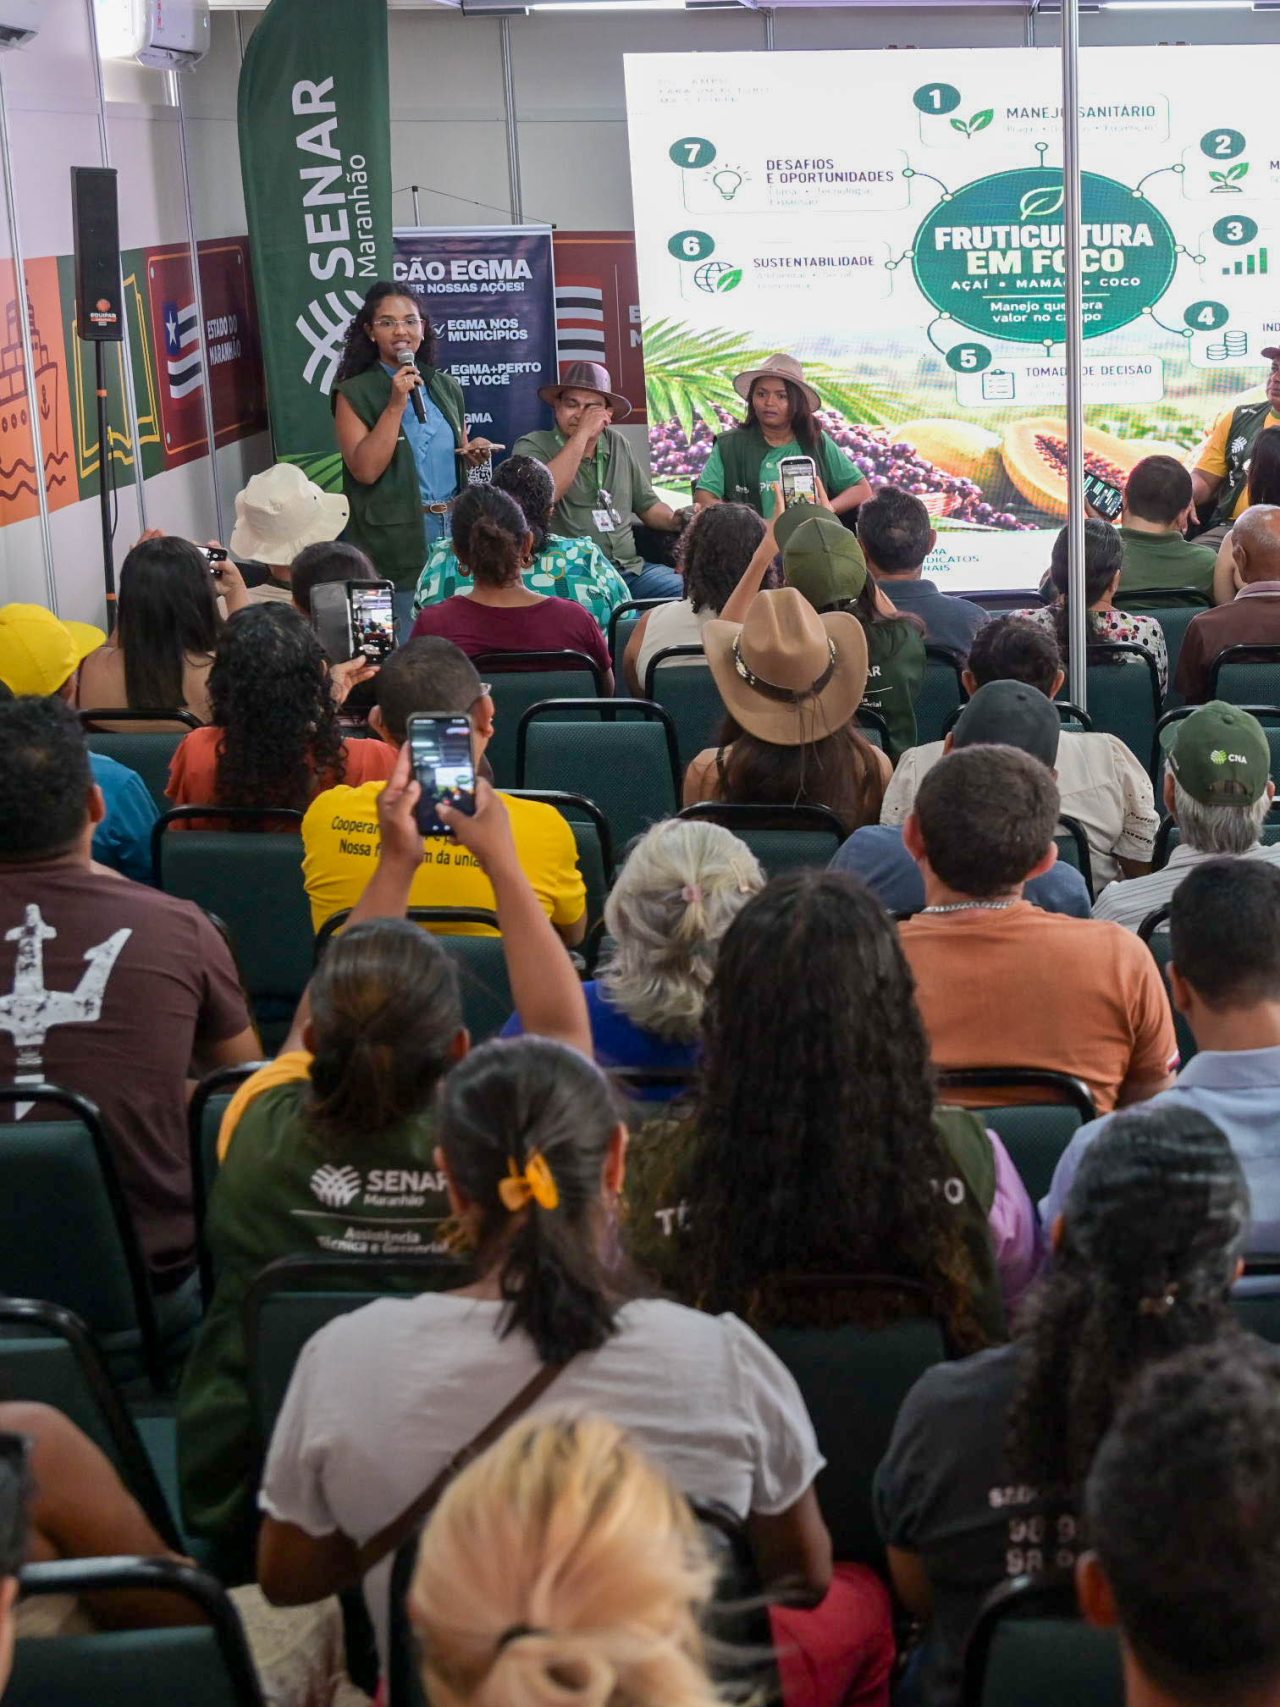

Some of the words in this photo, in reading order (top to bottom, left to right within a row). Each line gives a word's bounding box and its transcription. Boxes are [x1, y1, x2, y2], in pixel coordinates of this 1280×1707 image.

[930, 90, 940, 109] 1
[1006, 106, 1063, 118] MANEJ
[1215, 135, 1232, 154] 2
[683, 144, 701, 163] 7
[767, 159, 834, 171] DESAFIOS
[291, 76, 355, 281] SENAR
[767, 173, 774, 184] E
[780, 171, 894, 184] OPORTUNIDADES
[346, 154, 378, 277] Maranhão
[1227, 222, 1243, 241] 3
[682, 236, 701, 255] 6
[753, 255, 875, 268] SUSTENTABILIDADE
[966, 250, 1022, 275] EM
[450, 258, 533, 281] EGMA
[427, 282, 478, 294] NOSSAS
[480, 280, 525, 295] AÇÕES!
[951, 278, 988, 291] AÇAÍ
[1016, 276, 1065, 288] MAMÃ
[1100, 277, 1141, 287] COCO
[990, 301, 1039, 314] Manejo
[1081, 301, 1103, 311] era
[992, 312, 1027, 323] valor
[1033, 313, 1051, 323] no
[1197, 306, 1215, 325] 4
[447, 319, 485, 331] EGMA
[490, 318, 519, 330] NOS
[448, 328, 529, 342] MUNICÍPIOS
[960, 349, 977, 369] 5
[1025, 365, 1067, 377] TOMAD
[475, 373, 511, 386] VOCÊ
[463, 412, 493, 423] GMA
[1228, 753, 1248, 765] CNA
[331, 815, 381, 835] Cooperar
[339, 838, 372, 857] Nossa
[436, 850, 451, 865] da
